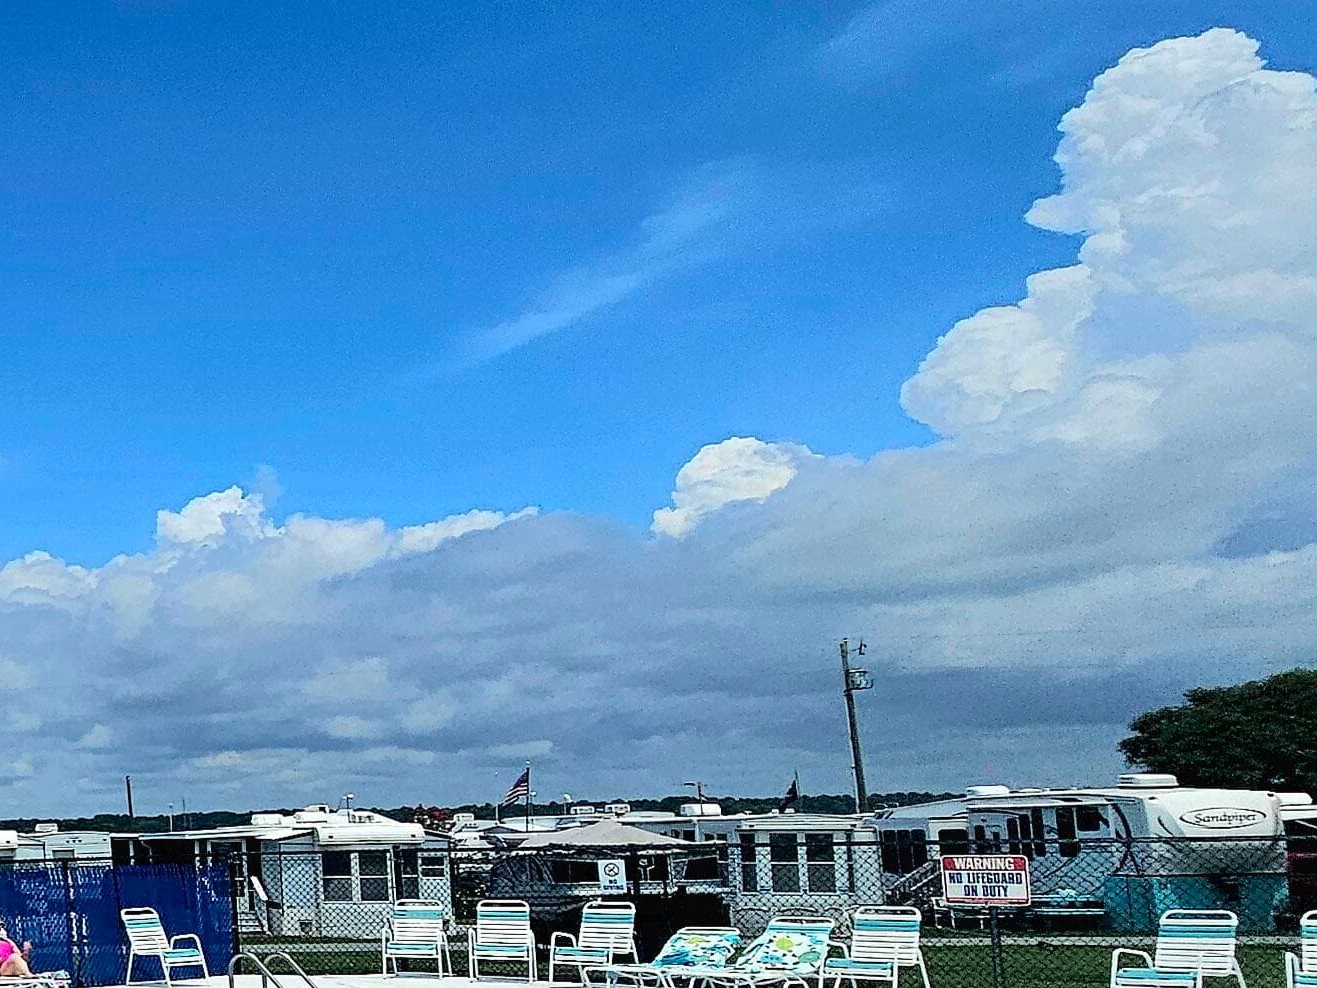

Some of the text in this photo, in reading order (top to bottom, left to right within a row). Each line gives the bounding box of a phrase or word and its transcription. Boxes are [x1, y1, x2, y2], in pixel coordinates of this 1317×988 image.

[1194, 811, 1256, 825] Sandpiper
[953, 857, 1015, 870] WARNING
[948, 872, 1022, 884] NO LIFEGUARD
[963, 885, 1008, 897] ON DUTY
